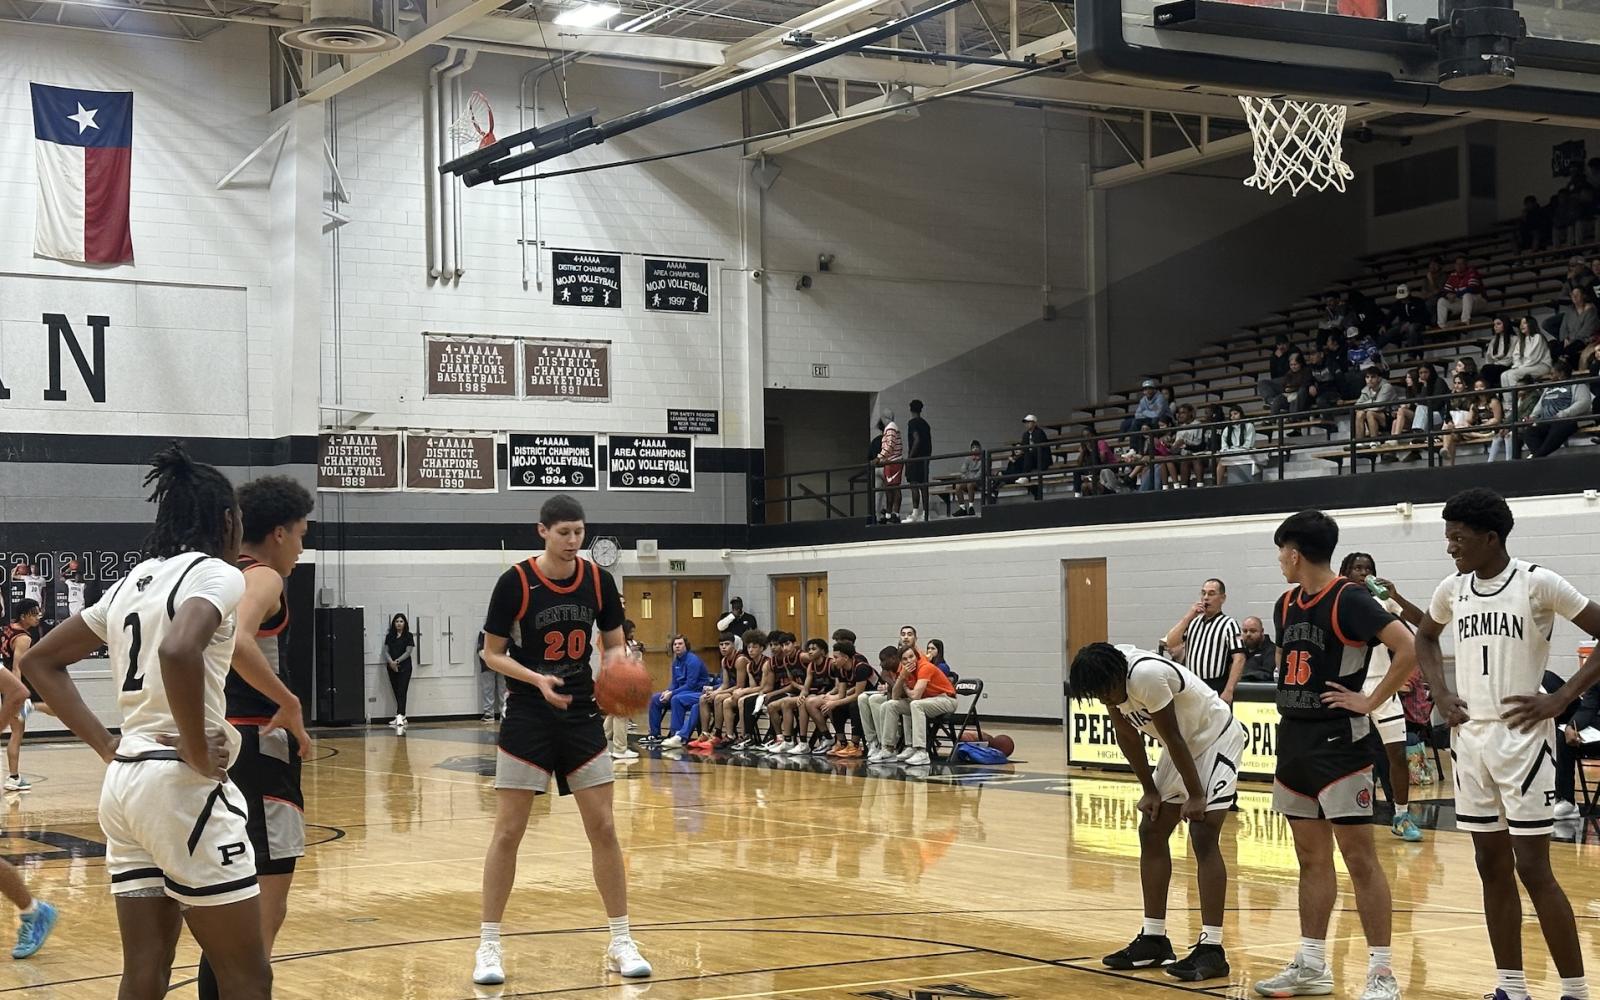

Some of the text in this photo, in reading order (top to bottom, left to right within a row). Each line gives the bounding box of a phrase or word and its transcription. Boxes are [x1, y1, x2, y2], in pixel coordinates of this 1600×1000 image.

[574, 255, 600, 264] 4-AAAAA
[558, 264, 615, 274] DISTRICT CHAMPIONS
[653, 269, 701, 279] AREA CHAMPIONS
[556, 274, 619, 290] MOJO VOLLEYBALL
[646, 278, 708, 296] MOJO VOLLEYBALL
[668, 296, 686, 306] 1997
[445, 344, 499, 356] 4-AAAAA
[542, 347, 591, 358] 4-AAAAA
[442, 354, 502, 365] DISTRICT
[538, 356, 597, 368] DISTRICT
[439, 363, 505, 374] CHAMPIONS
[533, 366, 600, 378] CHAMPIONS
[814, 366, 828, 376] EXIT
[437, 373, 507, 384] BASKETBALL
[531, 376, 603, 387] BASKETBALL
[458, 383, 487, 392] 1985
[554, 386, 581, 395] 1991
[328, 436, 378, 446] 4-AAAAA
[426, 438, 474, 448] 4-AAAAA
[534, 437, 569, 446] 4-AAAAA
[634, 438, 666, 448] 4-AAAAA
[328, 446, 378, 456] DISTRICT
[426, 448, 474, 459] DISTRICT
[514, 446, 590, 456] DISTRICT CHAMPIONS
[614, 448, 686, 458] AREA CHAMPIONS
[324, 456, 382, 466] CHAMPIONS
[422, 458, 479, 469] CHAMPIONS
[512, 456, 594, 468] MOJO VOLLEYBALL
[611, 459, 689, 474] MOJO VOLLEYBALL
[320, 466, 386, 477] VOLLEYBALL
[419, 468, 483, 479] VOLLEYBALL
[341, 476, 366, 487] 1989
[440, 479, 465, 488] 1990
[540, 476, 567, 484] 1994
[637, 476, 665, 485] 1994
[669, 560, 686, 572] EXIT
[536, 604, 594, 630] CENTRAL
[1458, 612, 1524, 642] PERMIAN
[544, 629, 586, 660] 20
[122, 612, 145, 692] 2
[1482, 645, 1489, 676] 1
[1284, 650, 1312, 686] 15
[1097, 750, 1118, 759] HIGH
[217, 841, 246, 866] P
